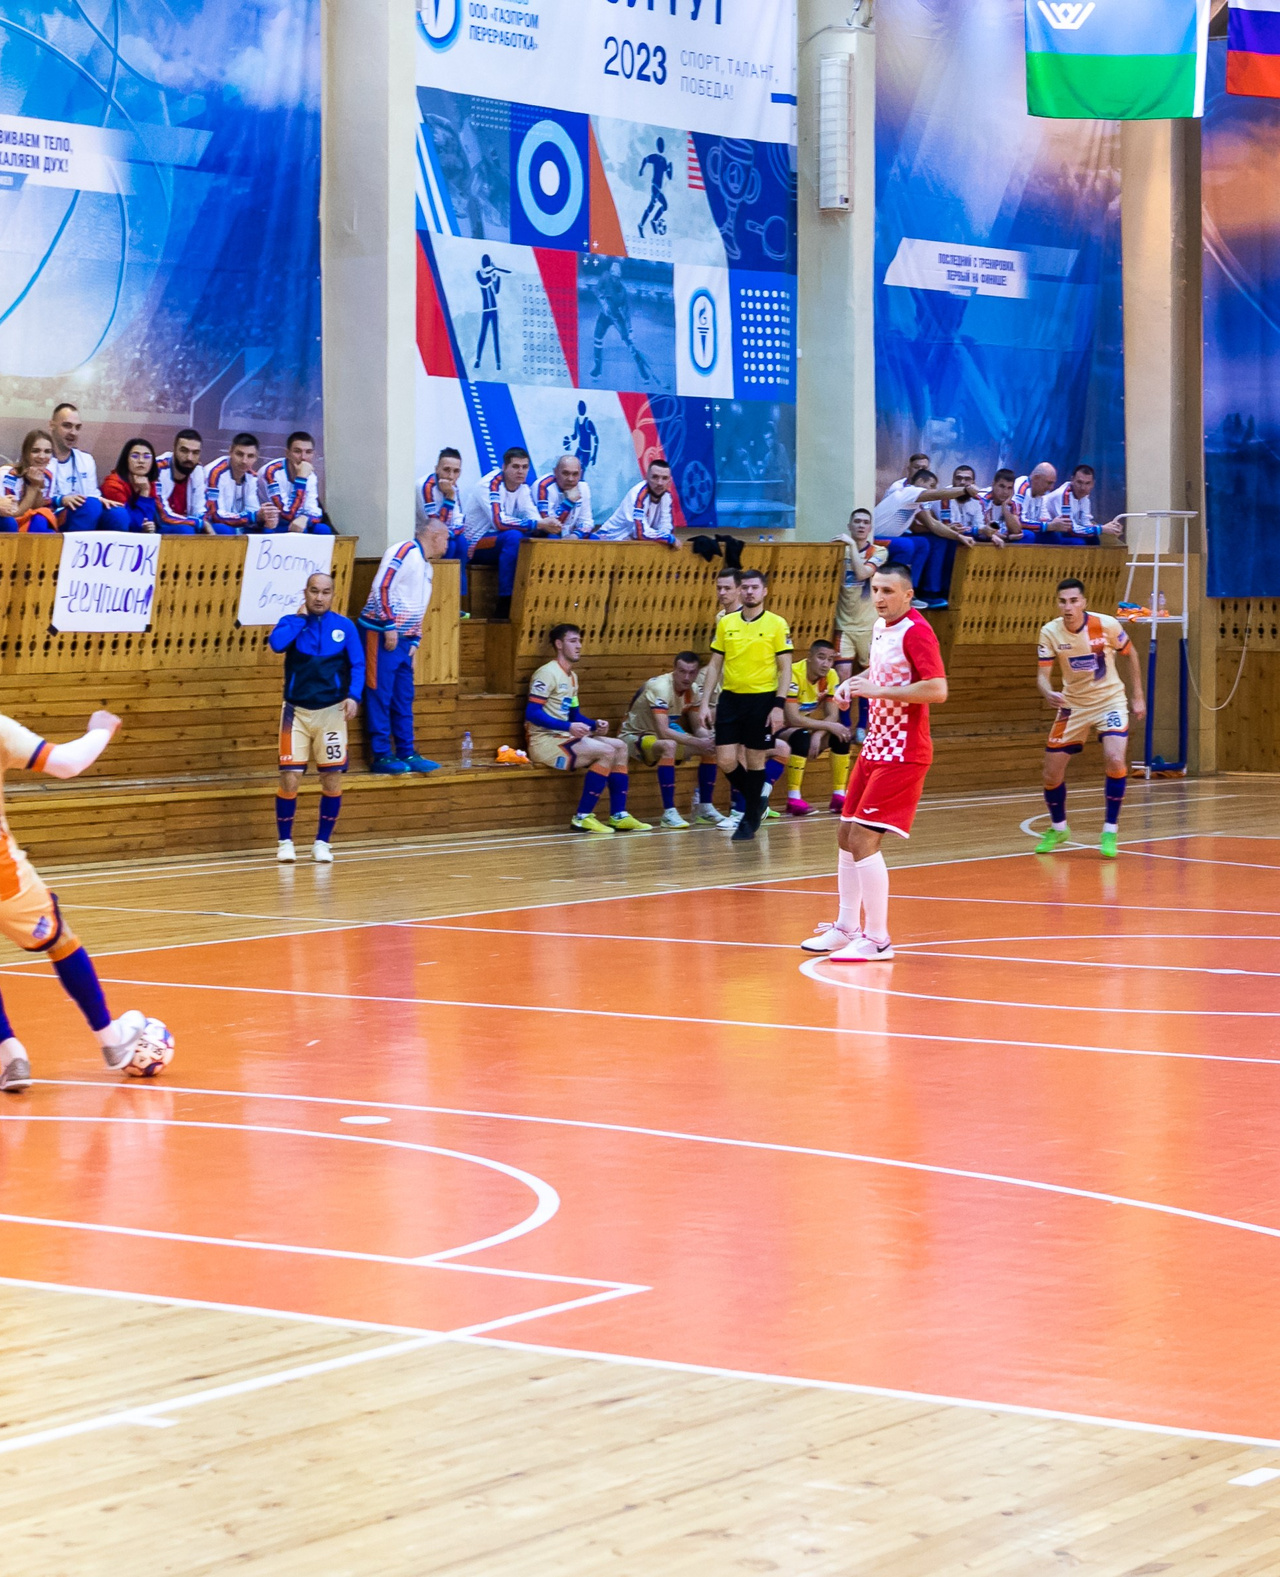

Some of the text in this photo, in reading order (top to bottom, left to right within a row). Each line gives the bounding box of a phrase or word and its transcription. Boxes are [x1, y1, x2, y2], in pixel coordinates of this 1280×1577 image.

[469, 2, 539, 29] ООО «ГАЗПРОМ
[469, 24, 539, 51] ПЕРЕРАБОТКА»
[604, 36, 667, 85] 2023
[680, 49, 779, 84] СПОРТ, ТАЛАНТ,
[680, 76, 734, 101] ПОБЕДА!
[43, 135, 74, 154] ТЕЛО,
[43, 156, 69, 174] ДУХ!
[71, 541, 158, 576] ВОСТОК
[326, 744, 342, 760] 93
